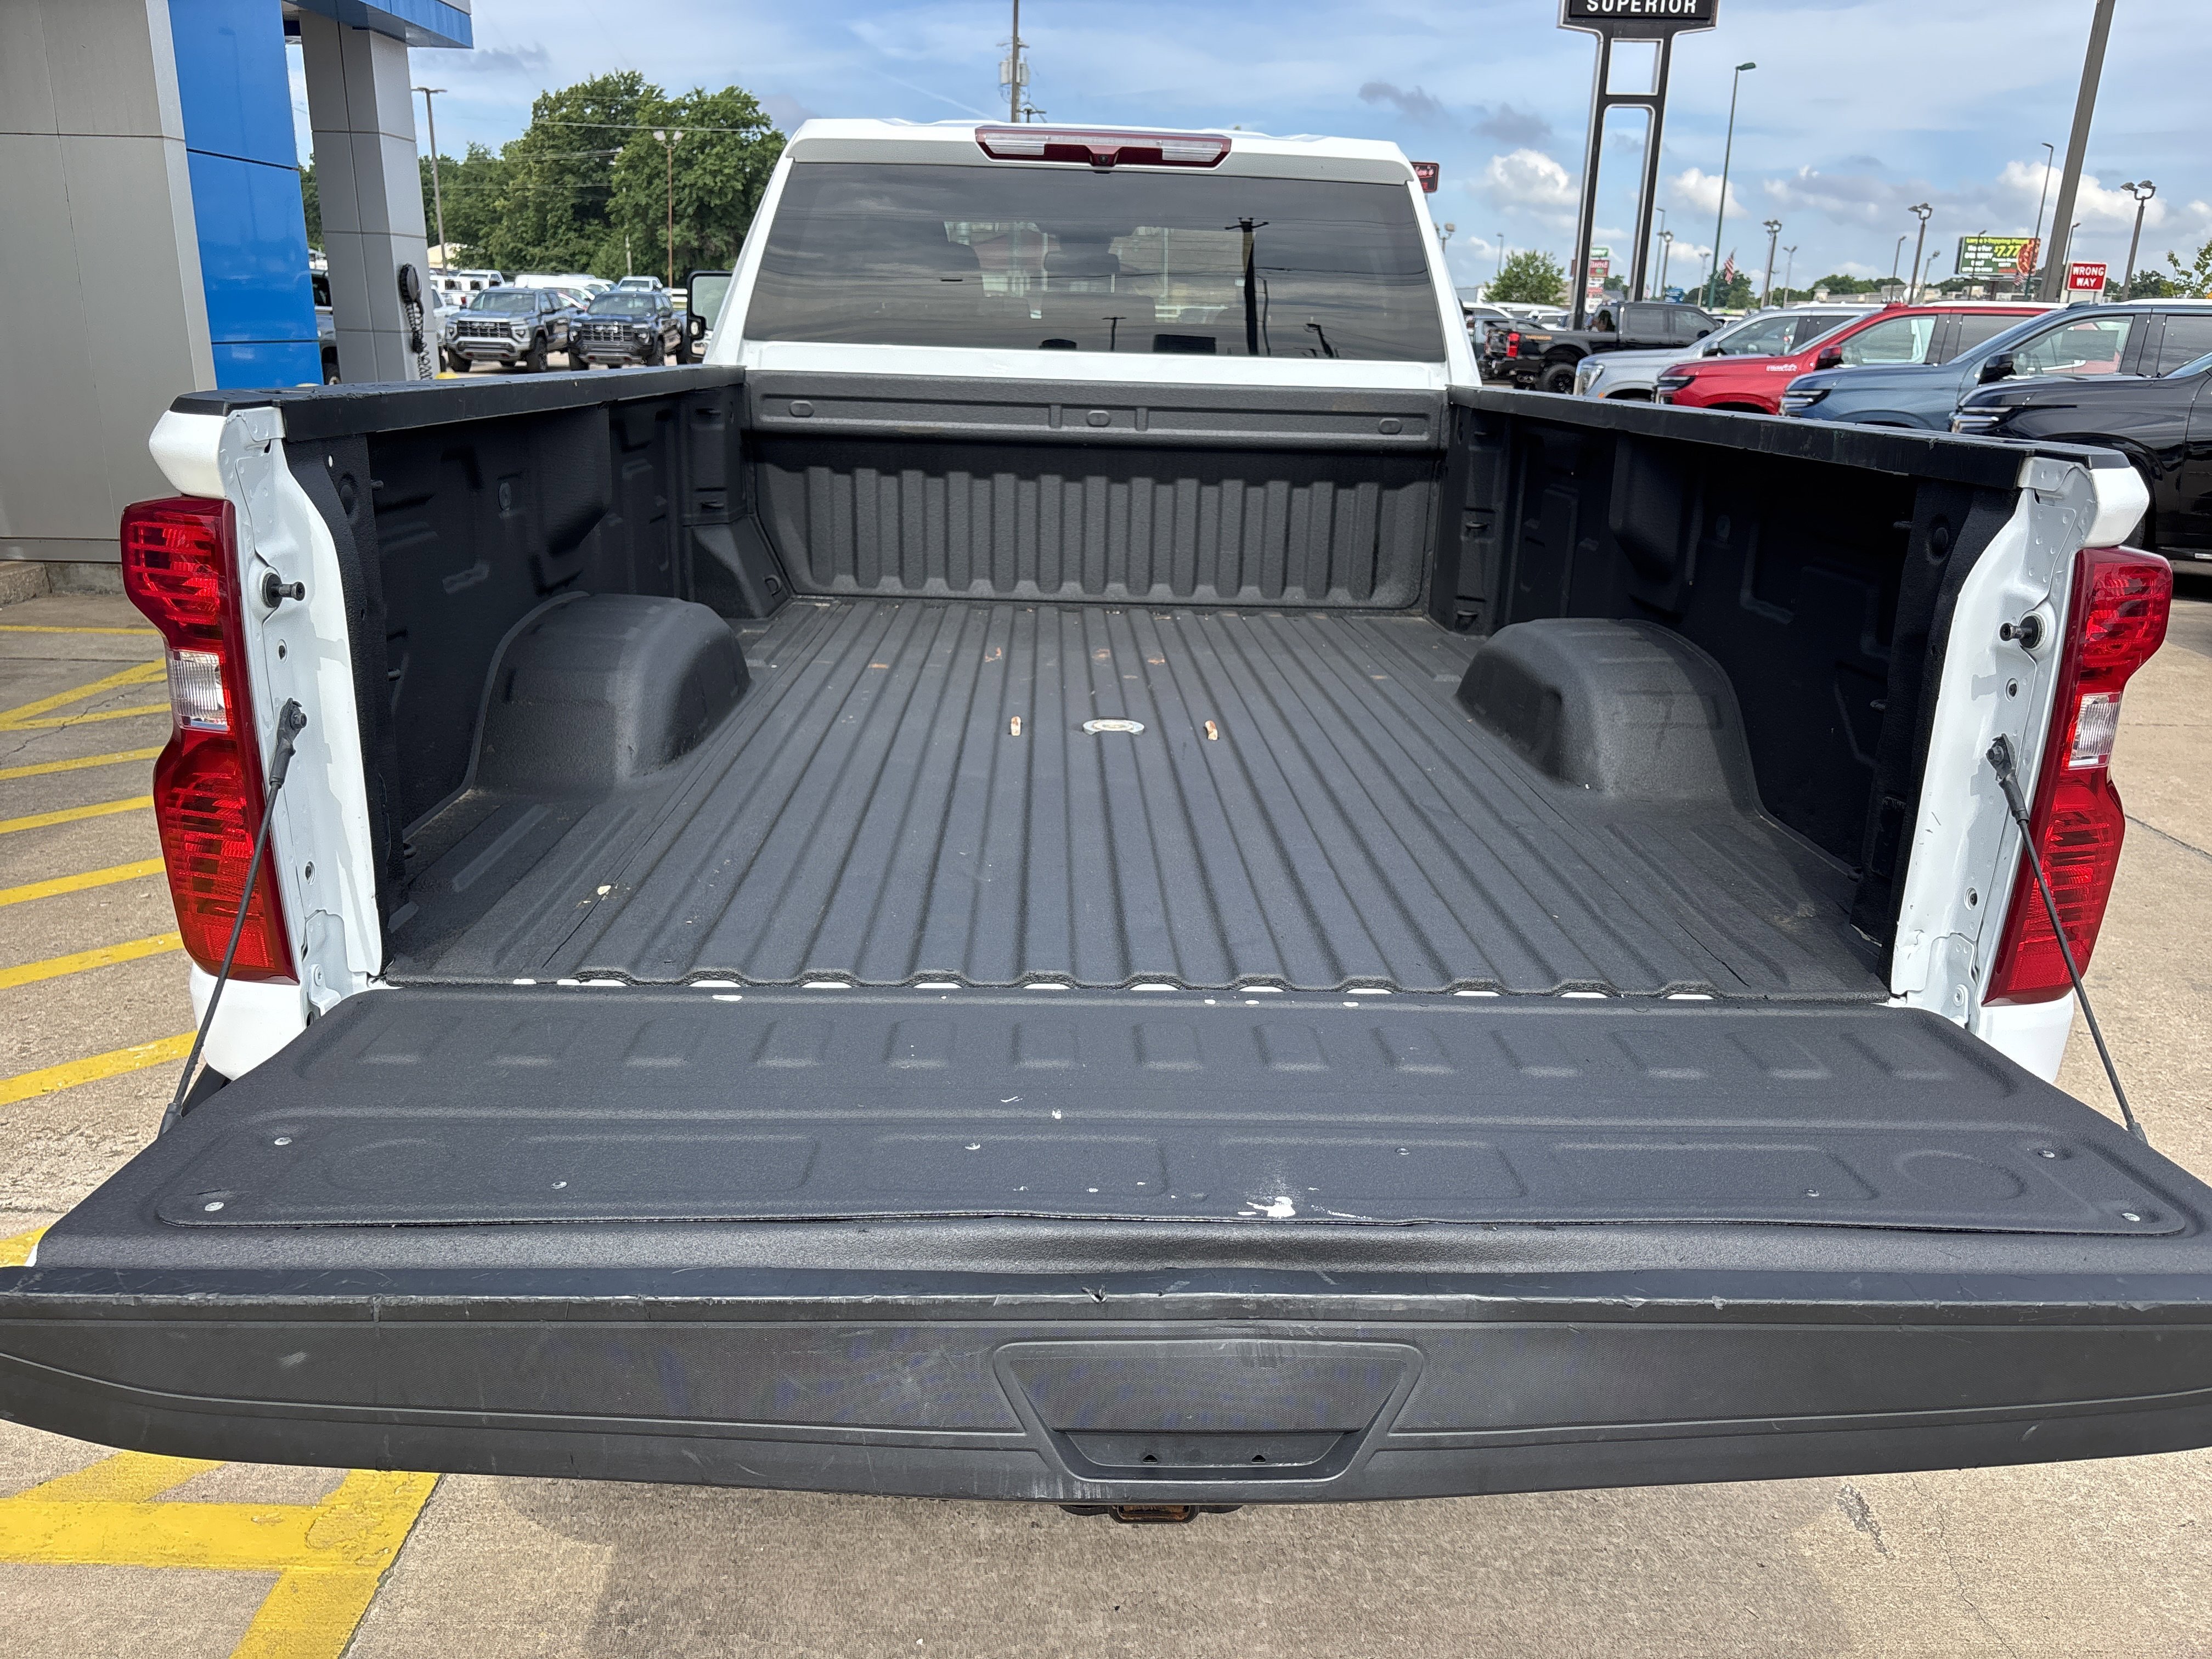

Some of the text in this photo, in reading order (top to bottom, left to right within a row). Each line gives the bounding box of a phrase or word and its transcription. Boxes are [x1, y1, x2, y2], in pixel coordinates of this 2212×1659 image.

[1586, 0, 1696, 14] SUPERIOR
[1994, 245, 2021, 257] $7.77
[2073, 266, 2104, 276] WRONG
[2076, 277, 2097, 287] WAY
